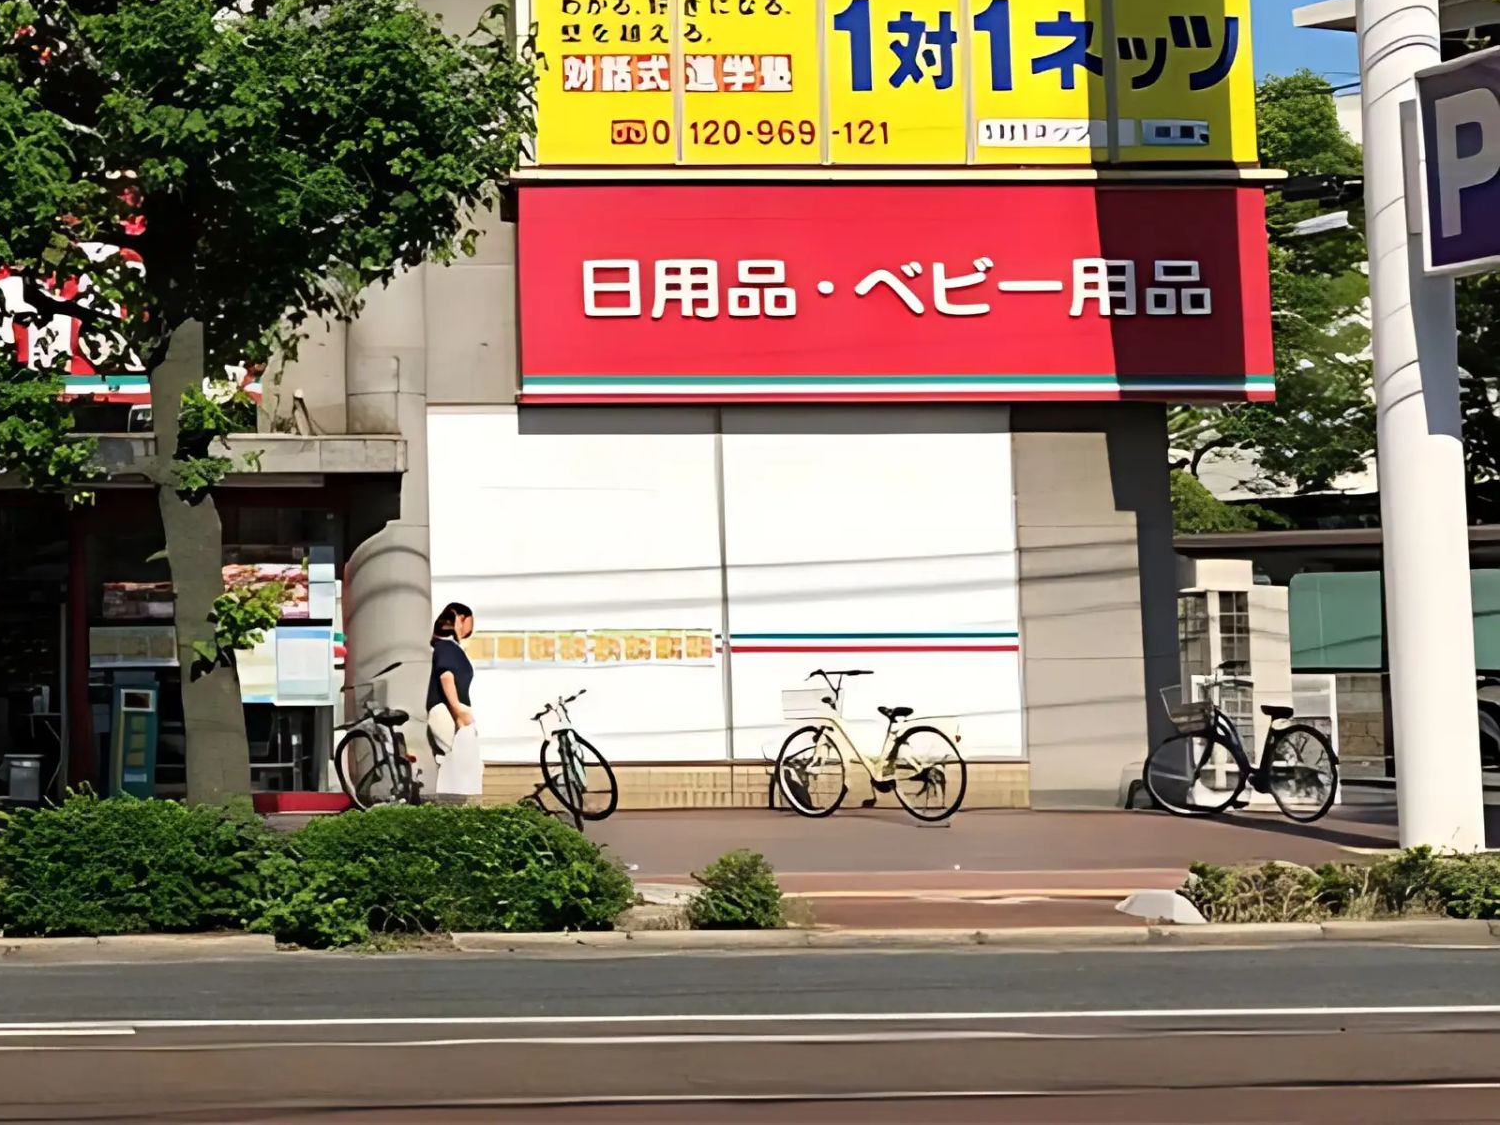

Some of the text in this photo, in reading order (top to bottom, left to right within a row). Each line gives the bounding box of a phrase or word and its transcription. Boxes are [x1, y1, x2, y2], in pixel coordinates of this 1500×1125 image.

[1435, 87, 1500, 238] P
[583, 256, 1213, 320] 日用品・ベビー用品
